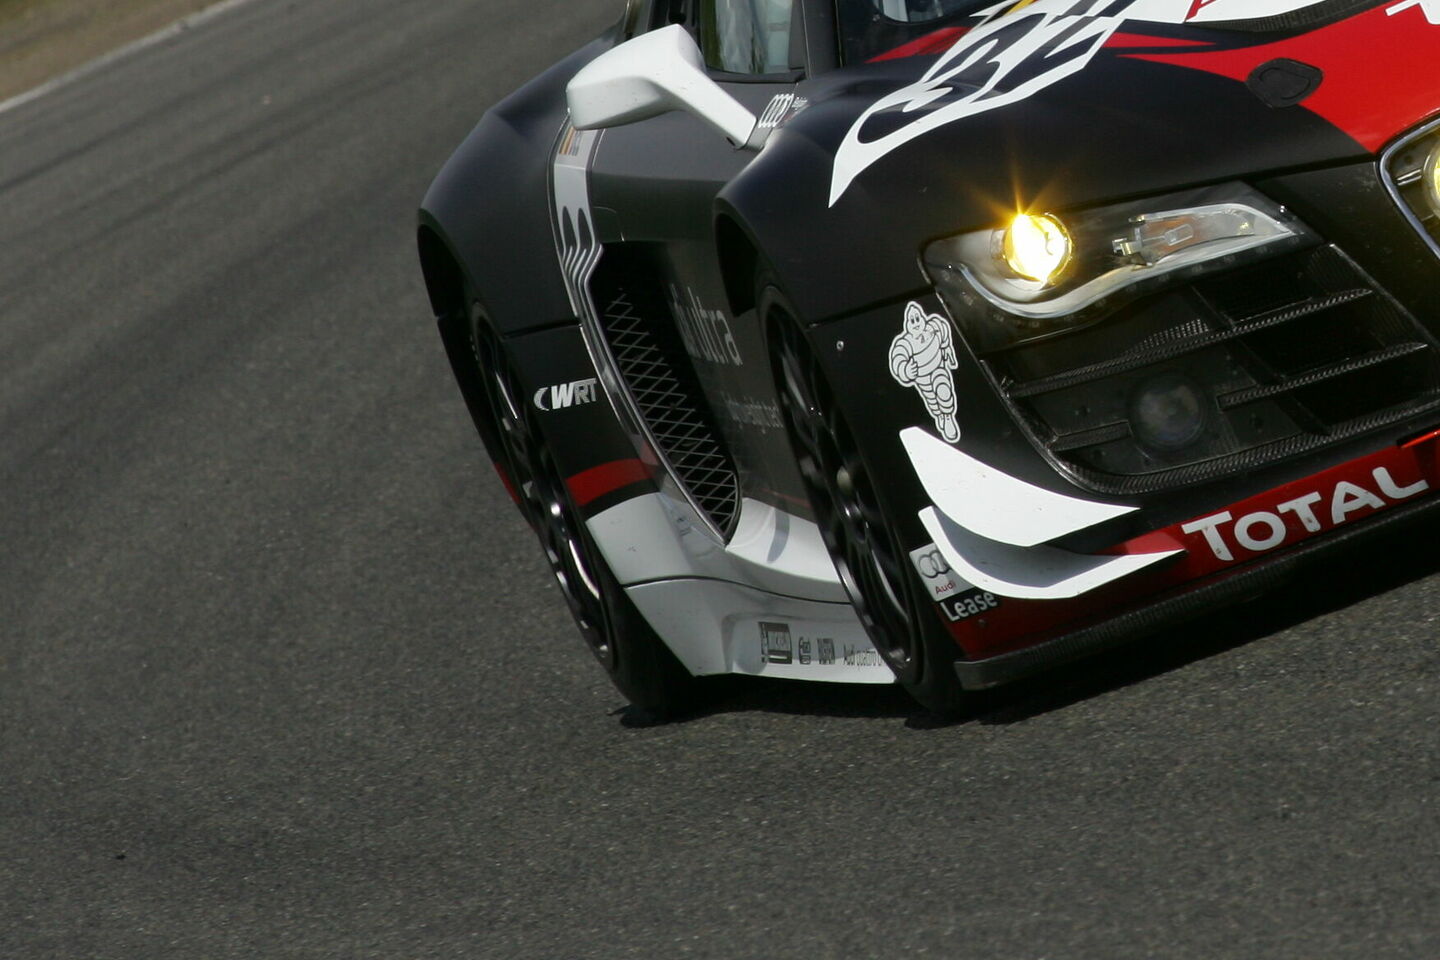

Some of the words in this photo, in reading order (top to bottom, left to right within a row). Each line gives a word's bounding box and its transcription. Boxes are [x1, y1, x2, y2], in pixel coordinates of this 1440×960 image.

[551, 377, 598, 410] WRT
[1181, 466, 1430, 561] TOTAL
[935, 580, 957, 595] Audi
[939, 591, 999, 622] Lease
